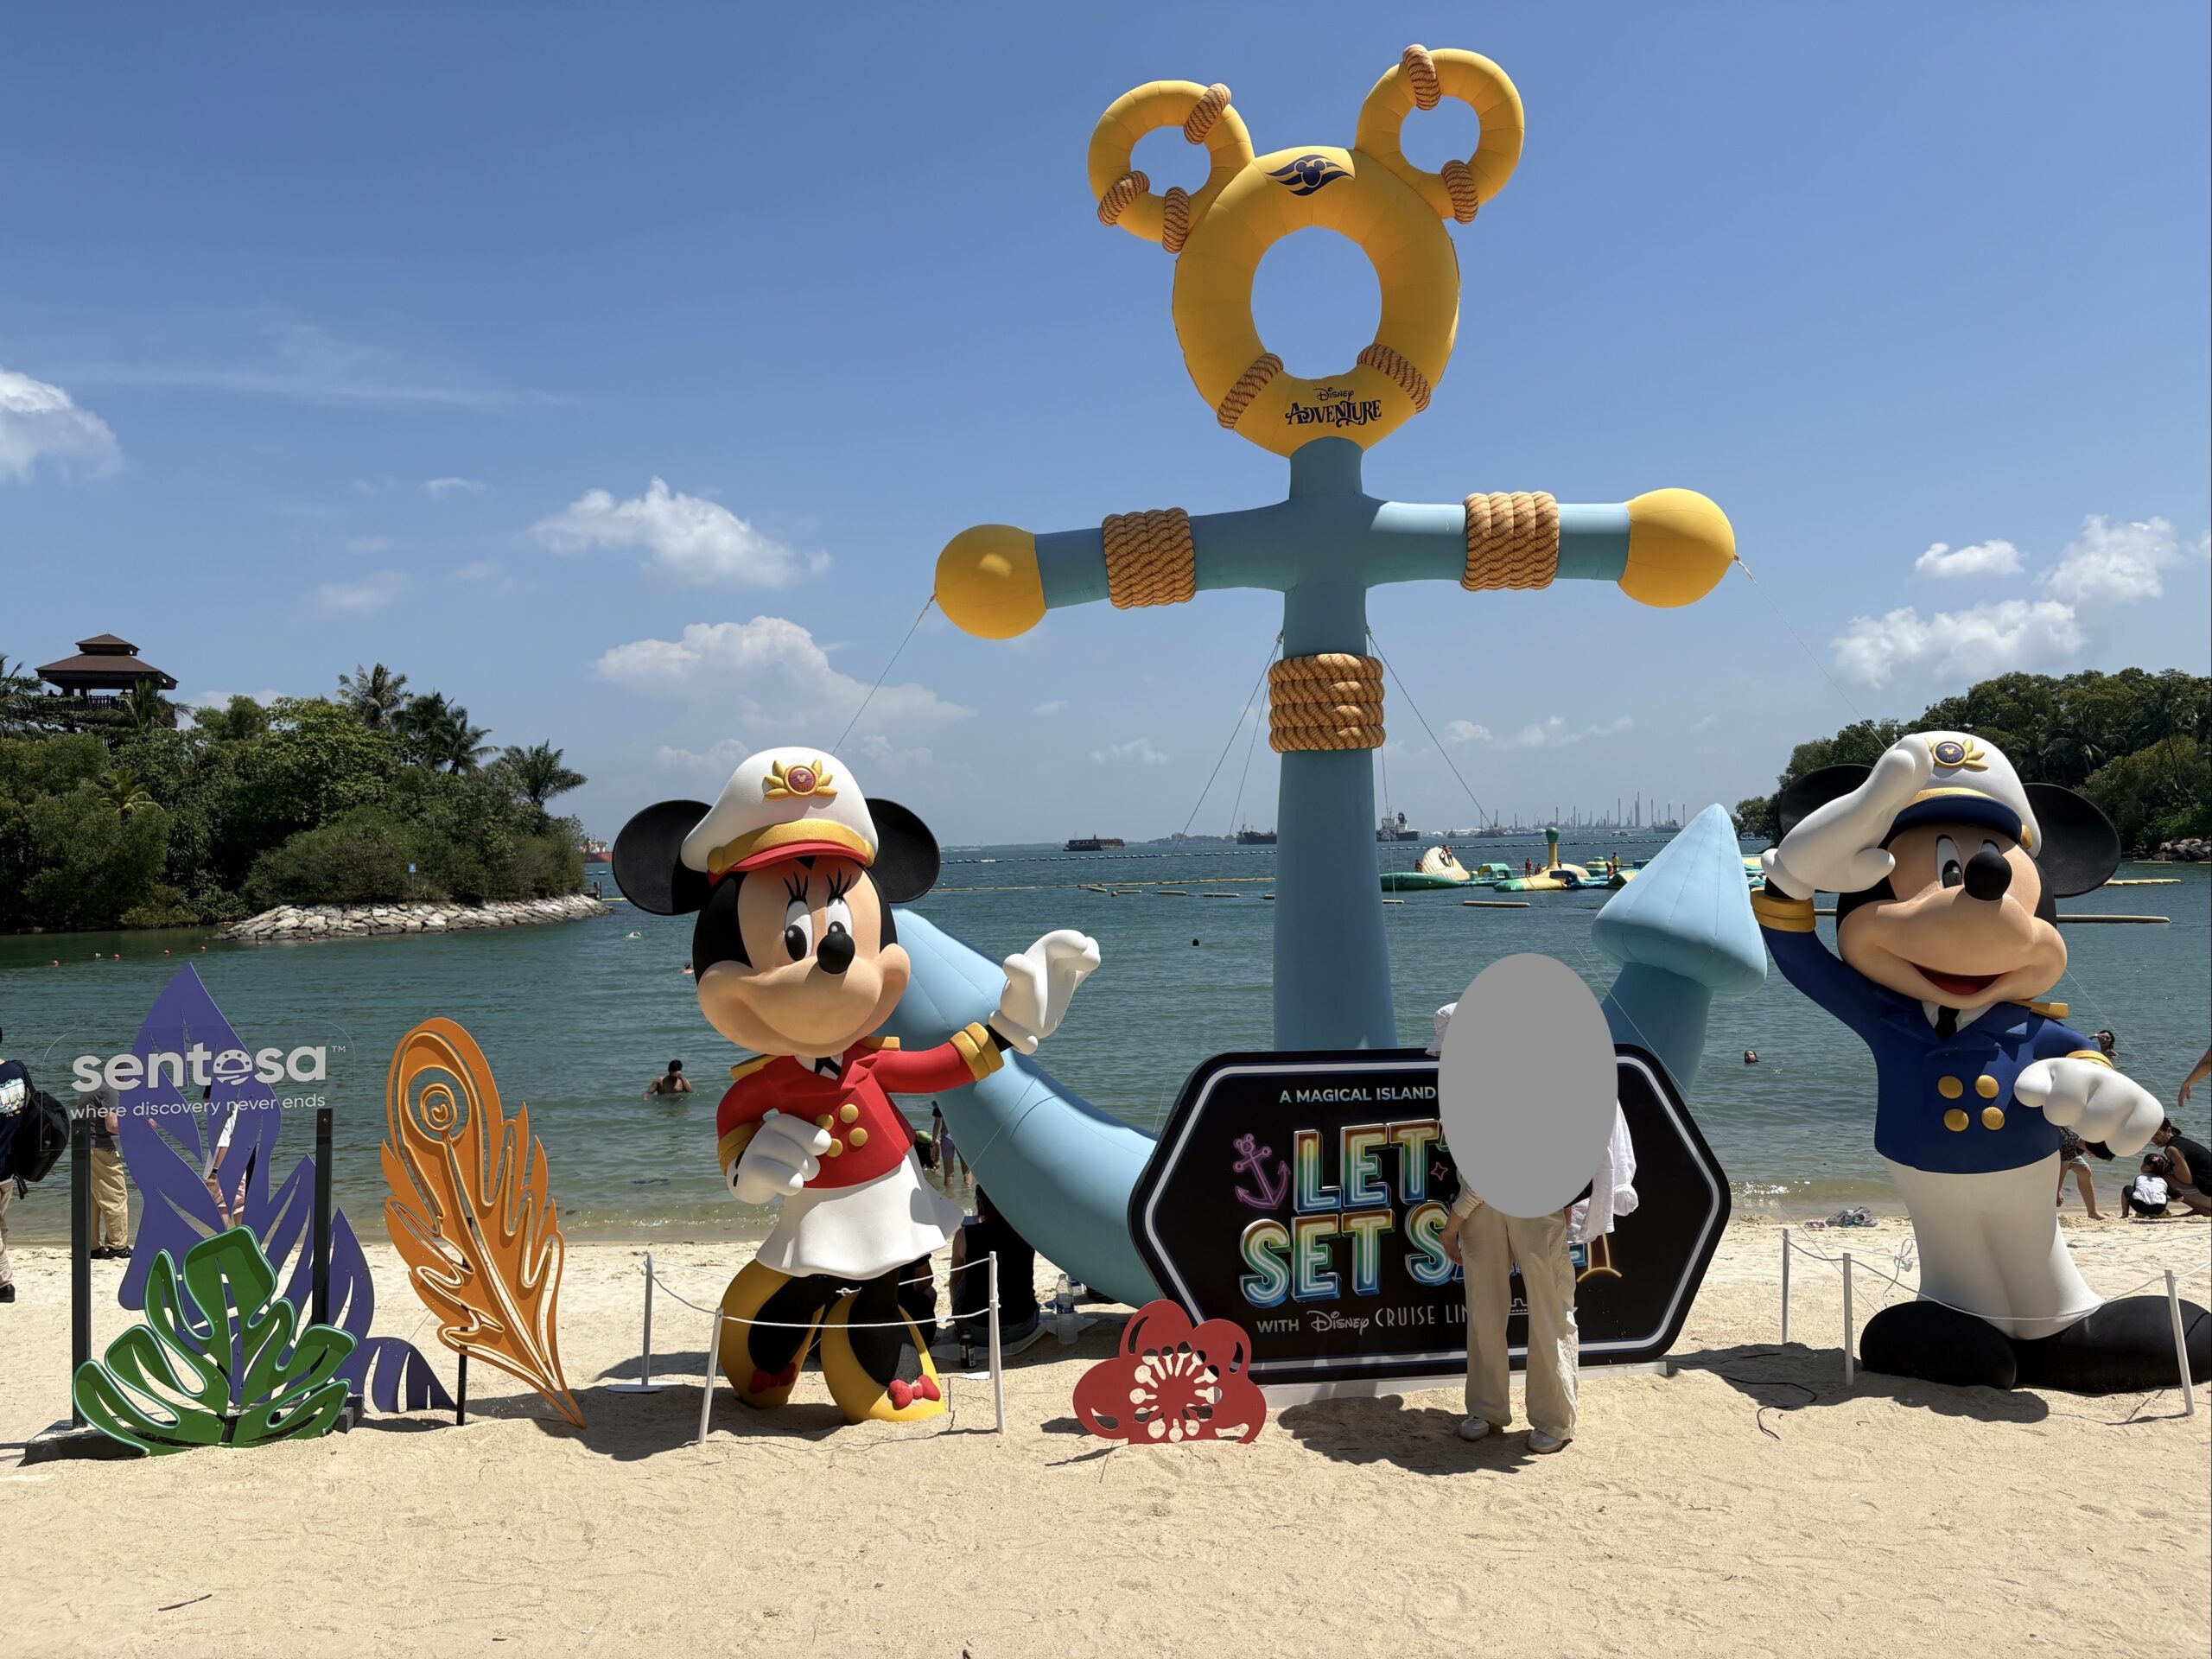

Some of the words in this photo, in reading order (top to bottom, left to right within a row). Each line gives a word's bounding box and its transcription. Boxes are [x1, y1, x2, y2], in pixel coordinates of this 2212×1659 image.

[1313, 386, 1354, 401] Disney
[1285, 399, 1382, 428] ADVENTURE
[71, 1042, 326, 1092] sentosa
[71, 1104, 127, 1119] where
[132, 1097, 220, 1116] discovery
[226, 1096, 276, 1111] never
[282, 1093, 326, 1109] ends
[1279, 1090, 1292, 1103] A
[1296, 1089, 1372, 1103] MAGICAL
[1376, 1086, 1437, 1100] ISLAND
[1240, 1208, 1395, 1308] SET
[1256, 1319, 1300, 1333] WITH
[1306, 1310, 1370, 1336] Disney
[1375, 1306, 1435, 1327] CRUISE
